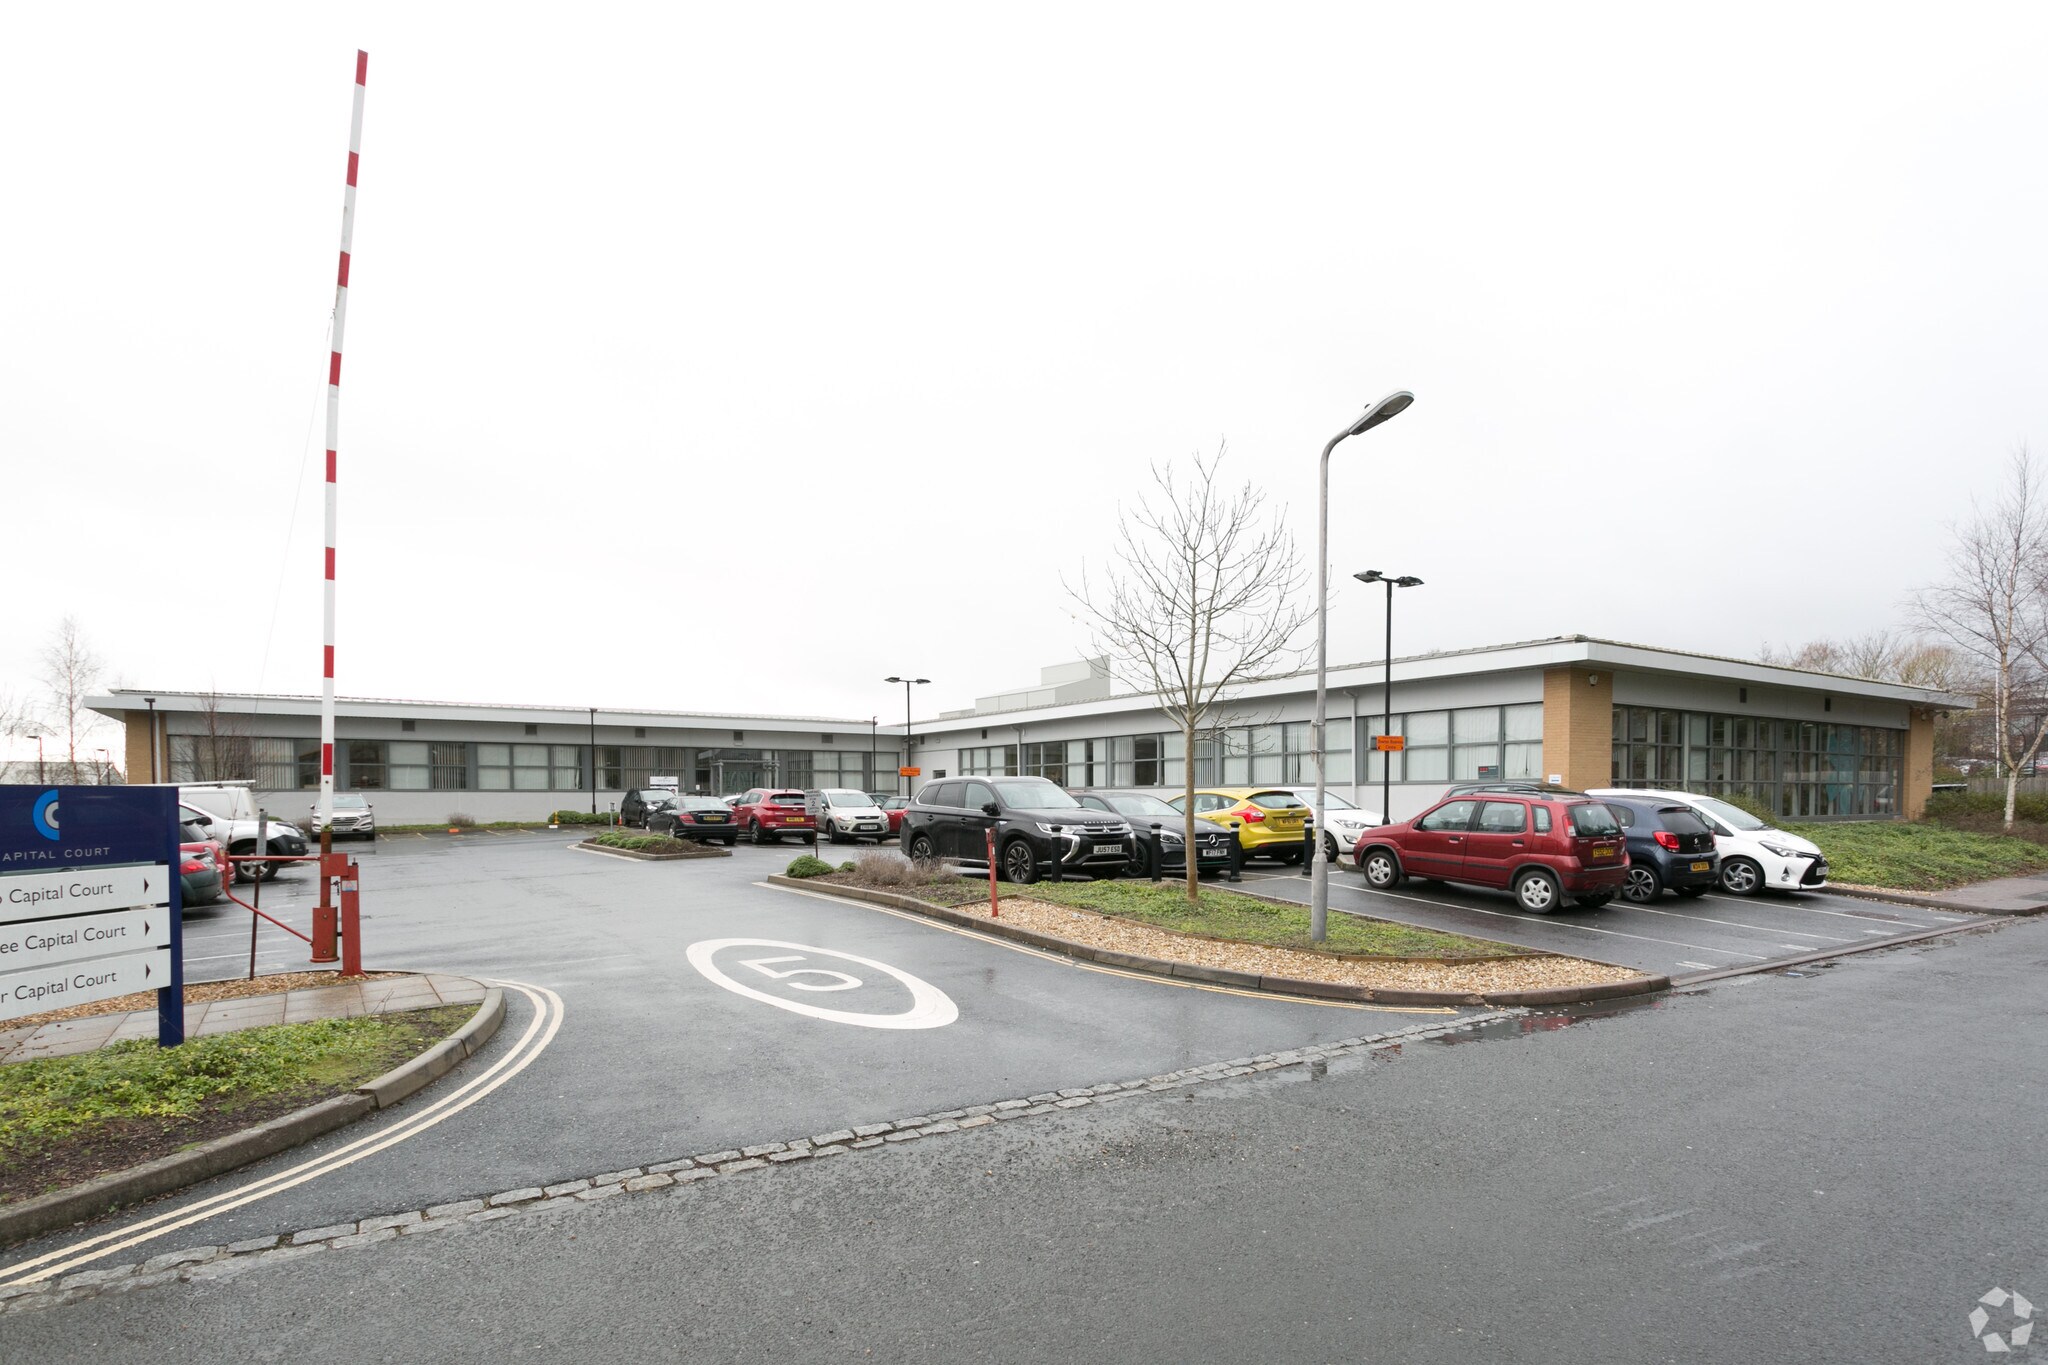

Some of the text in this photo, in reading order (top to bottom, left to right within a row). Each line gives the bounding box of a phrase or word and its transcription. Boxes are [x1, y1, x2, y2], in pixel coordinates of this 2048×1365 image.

[2, 847, 111, 862] APITAL COURT
[9, 885, 63, 906] Capital
[69, 883, 114, 898] Court
[25, 930, 77, 951] Capital
[83, 927, 127, 942] Court
[737, 955, 863, 991] 5
[15, 978, 68, 1001] Capital
[73, 972, 117, 989] Court
